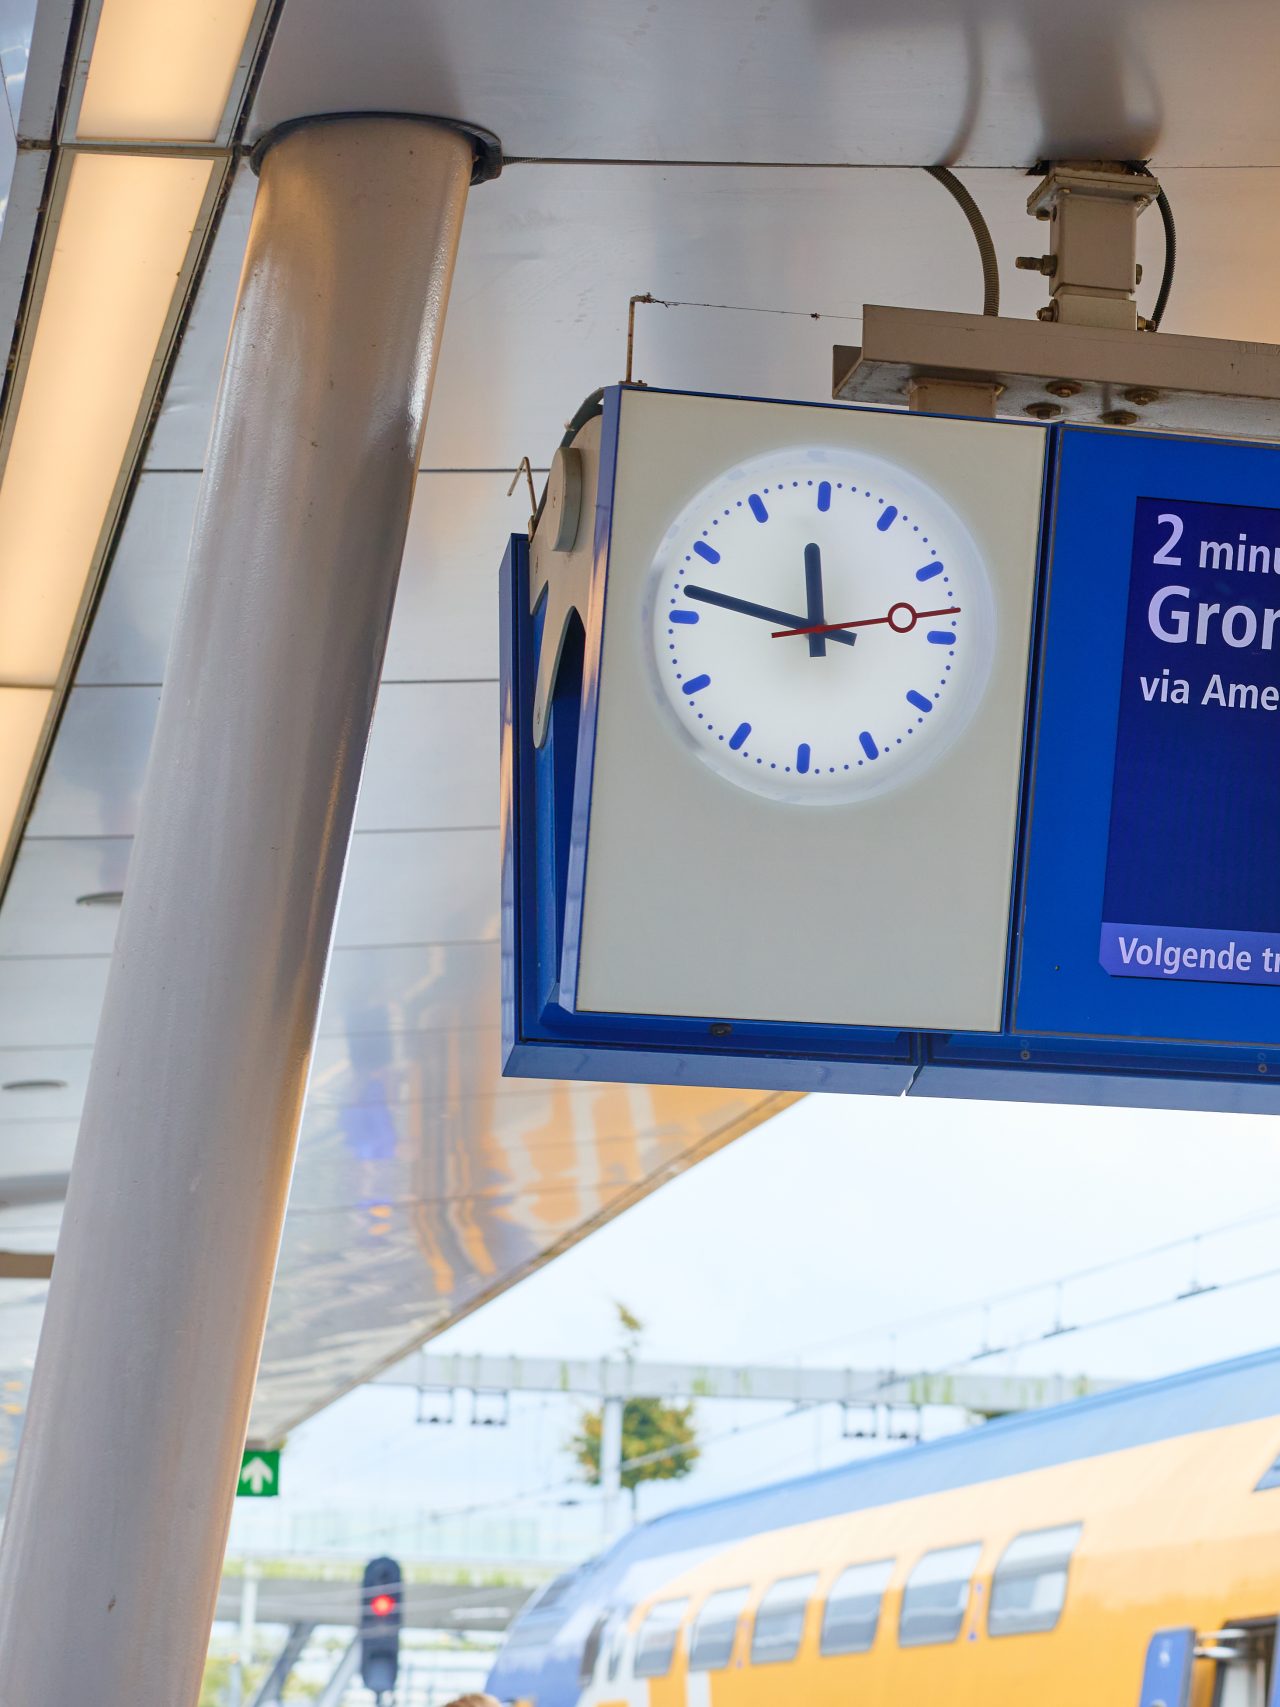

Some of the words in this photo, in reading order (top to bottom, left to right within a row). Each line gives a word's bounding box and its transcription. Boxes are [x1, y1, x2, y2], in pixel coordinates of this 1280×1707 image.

[1153, 513, 1184, 566] 2
[1139, 670, 1190, 704] via
[1118, 936, 1252, 975] Volgende
